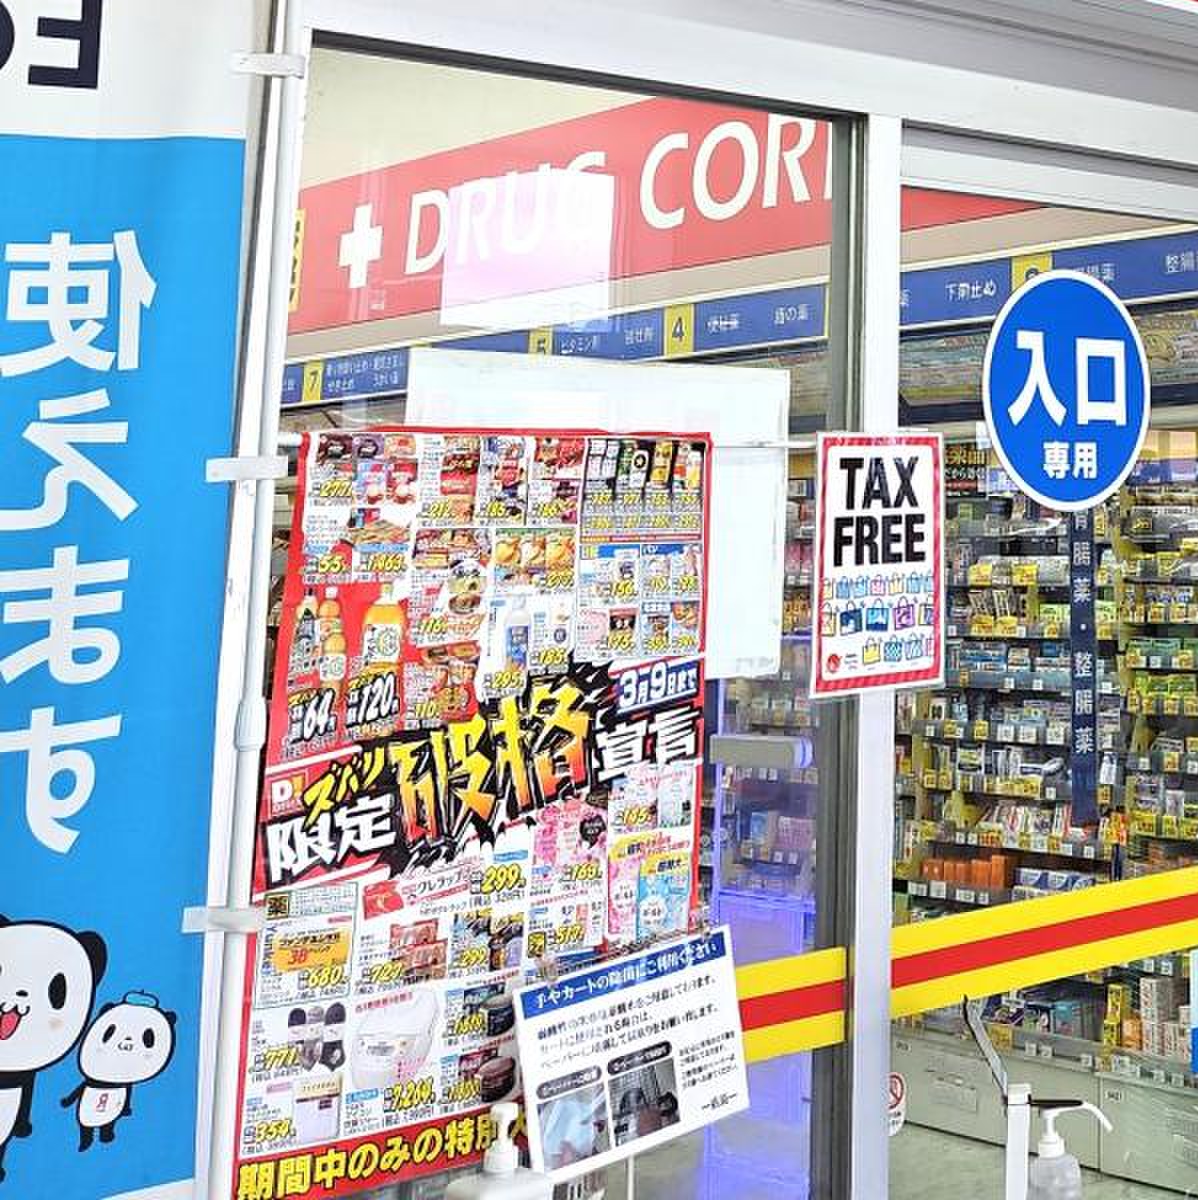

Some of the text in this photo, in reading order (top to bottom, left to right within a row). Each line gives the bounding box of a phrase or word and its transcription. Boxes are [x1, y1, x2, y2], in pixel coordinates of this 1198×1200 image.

[405, 150, 612, 277] DRUG
[639, 112, 833, 231] COR
[671, 316, 686, 343] 4
[1007, 329, 1127, 427] 入口
[839, 456, 919, 511] TAX
[1043, 441, 1097, 480] 専用
[832, 513, 926, 567] FREE
[357, 672, 397, 724] 120
[303, 747, 385, 829] ズバリ
[267, 793, 397, 884] 限定
[480, 863, 522, 894] 299
[307, 966, 343, 988] 680
[236, 1112, 526, 1200] 期間中のみの特
